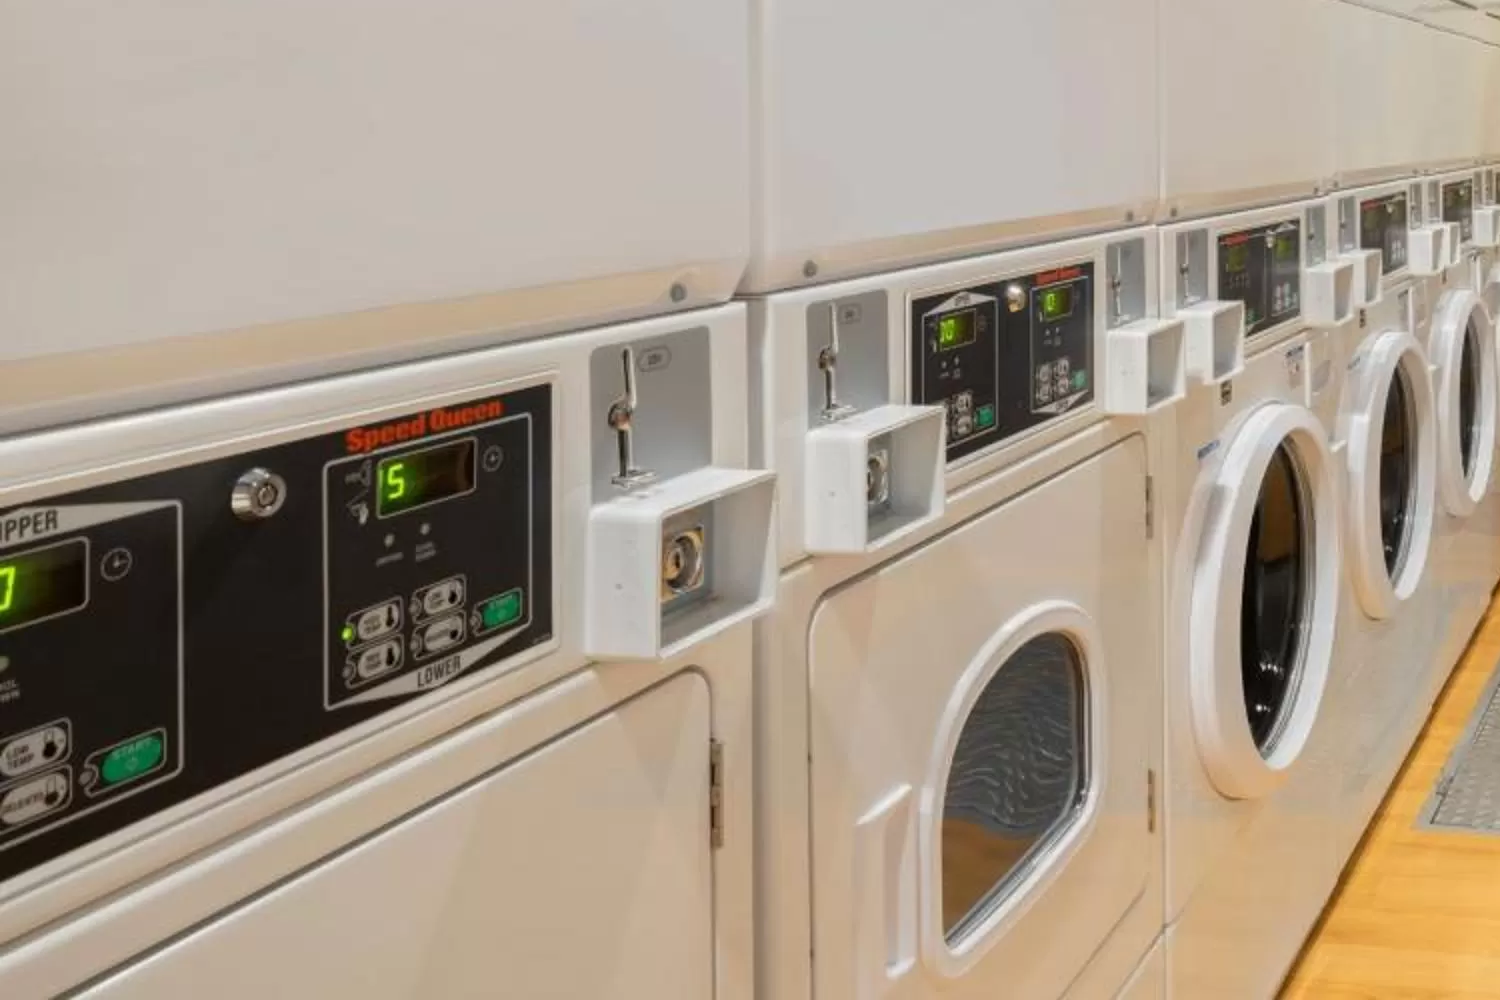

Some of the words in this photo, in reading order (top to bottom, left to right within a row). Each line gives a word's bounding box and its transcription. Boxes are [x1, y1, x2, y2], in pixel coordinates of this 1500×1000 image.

[345, 412, 425, 454] Speed
[429, 401, 505, 431] Queen
[0, 509, 58, 542] PPER
[417, 655, 462, 688] LOWER
